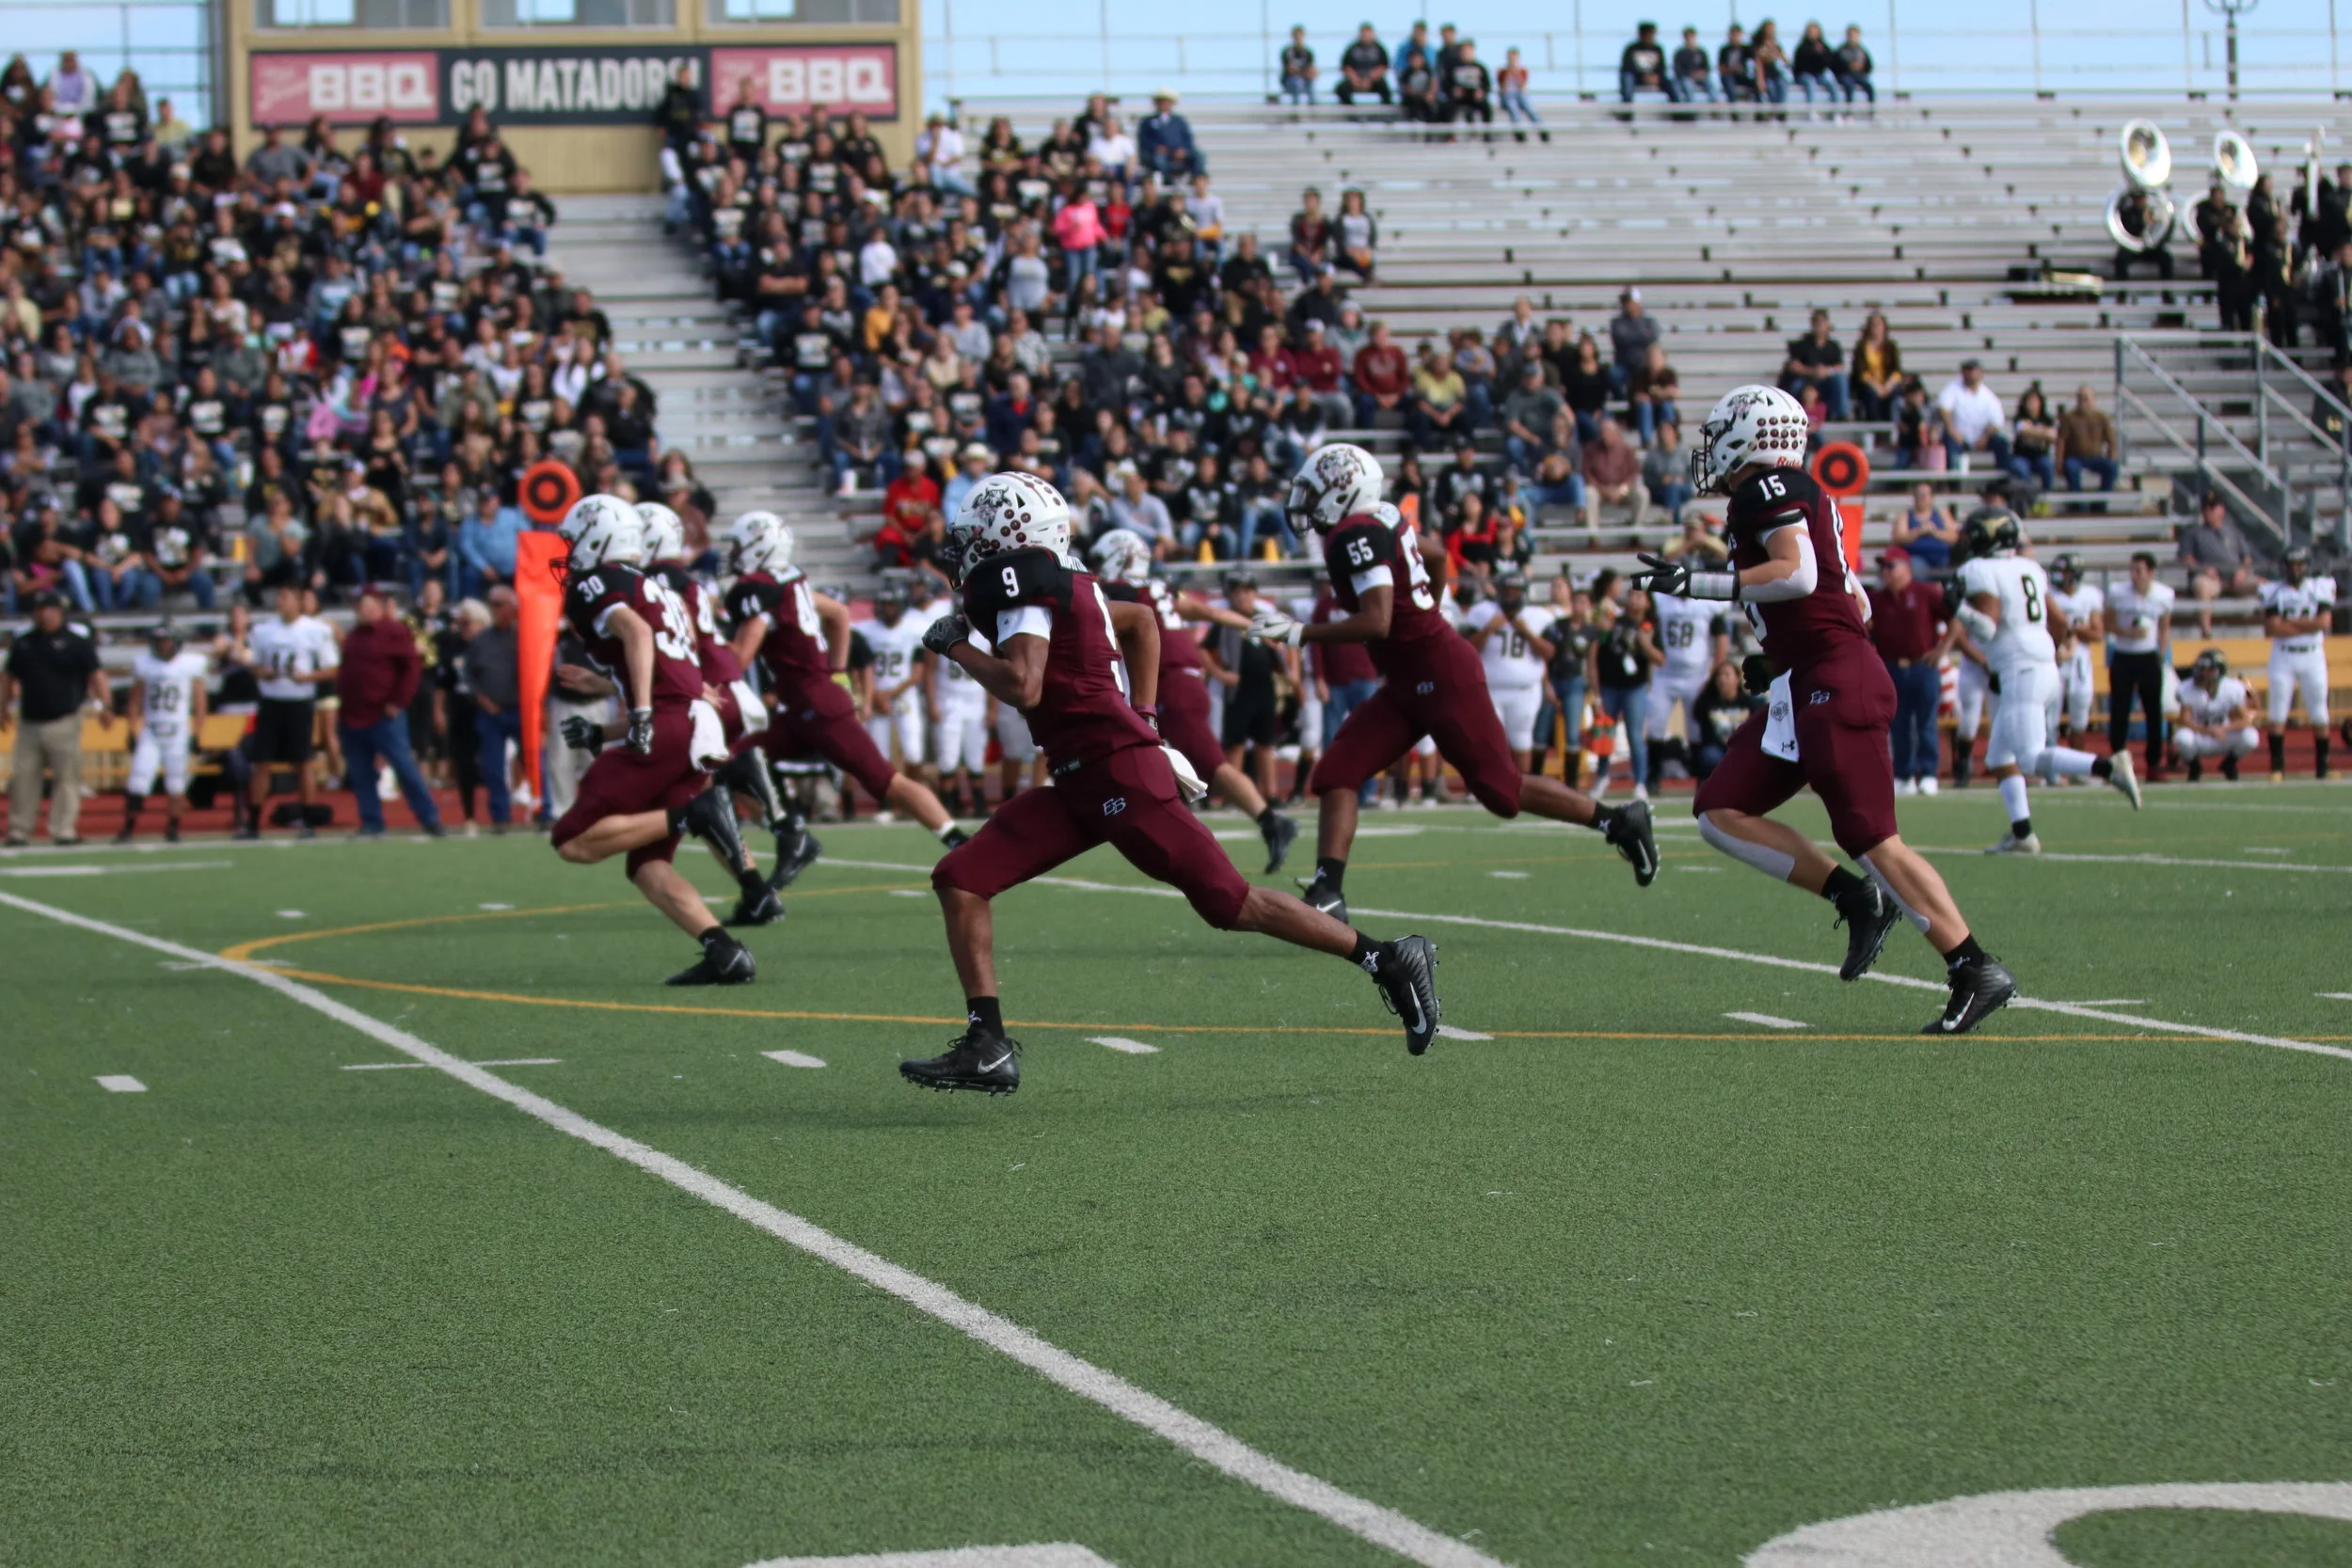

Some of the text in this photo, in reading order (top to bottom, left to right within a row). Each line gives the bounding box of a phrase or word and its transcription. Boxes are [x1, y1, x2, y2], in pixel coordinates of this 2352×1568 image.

[309, 63, 434, 111] BBQ
[451, 59, 499, 112] GO
[768, 57, 893, 103] BBQ
[1757, 474, 1787, 501] 15
[1345, 536, 1375, 566] 55
[577, 575, 606, 603] 30
[1001, 566, 1020, 597] 9
[2021, 574, 2042, 623] 8
[1103, 797, 1126, 816] EB
